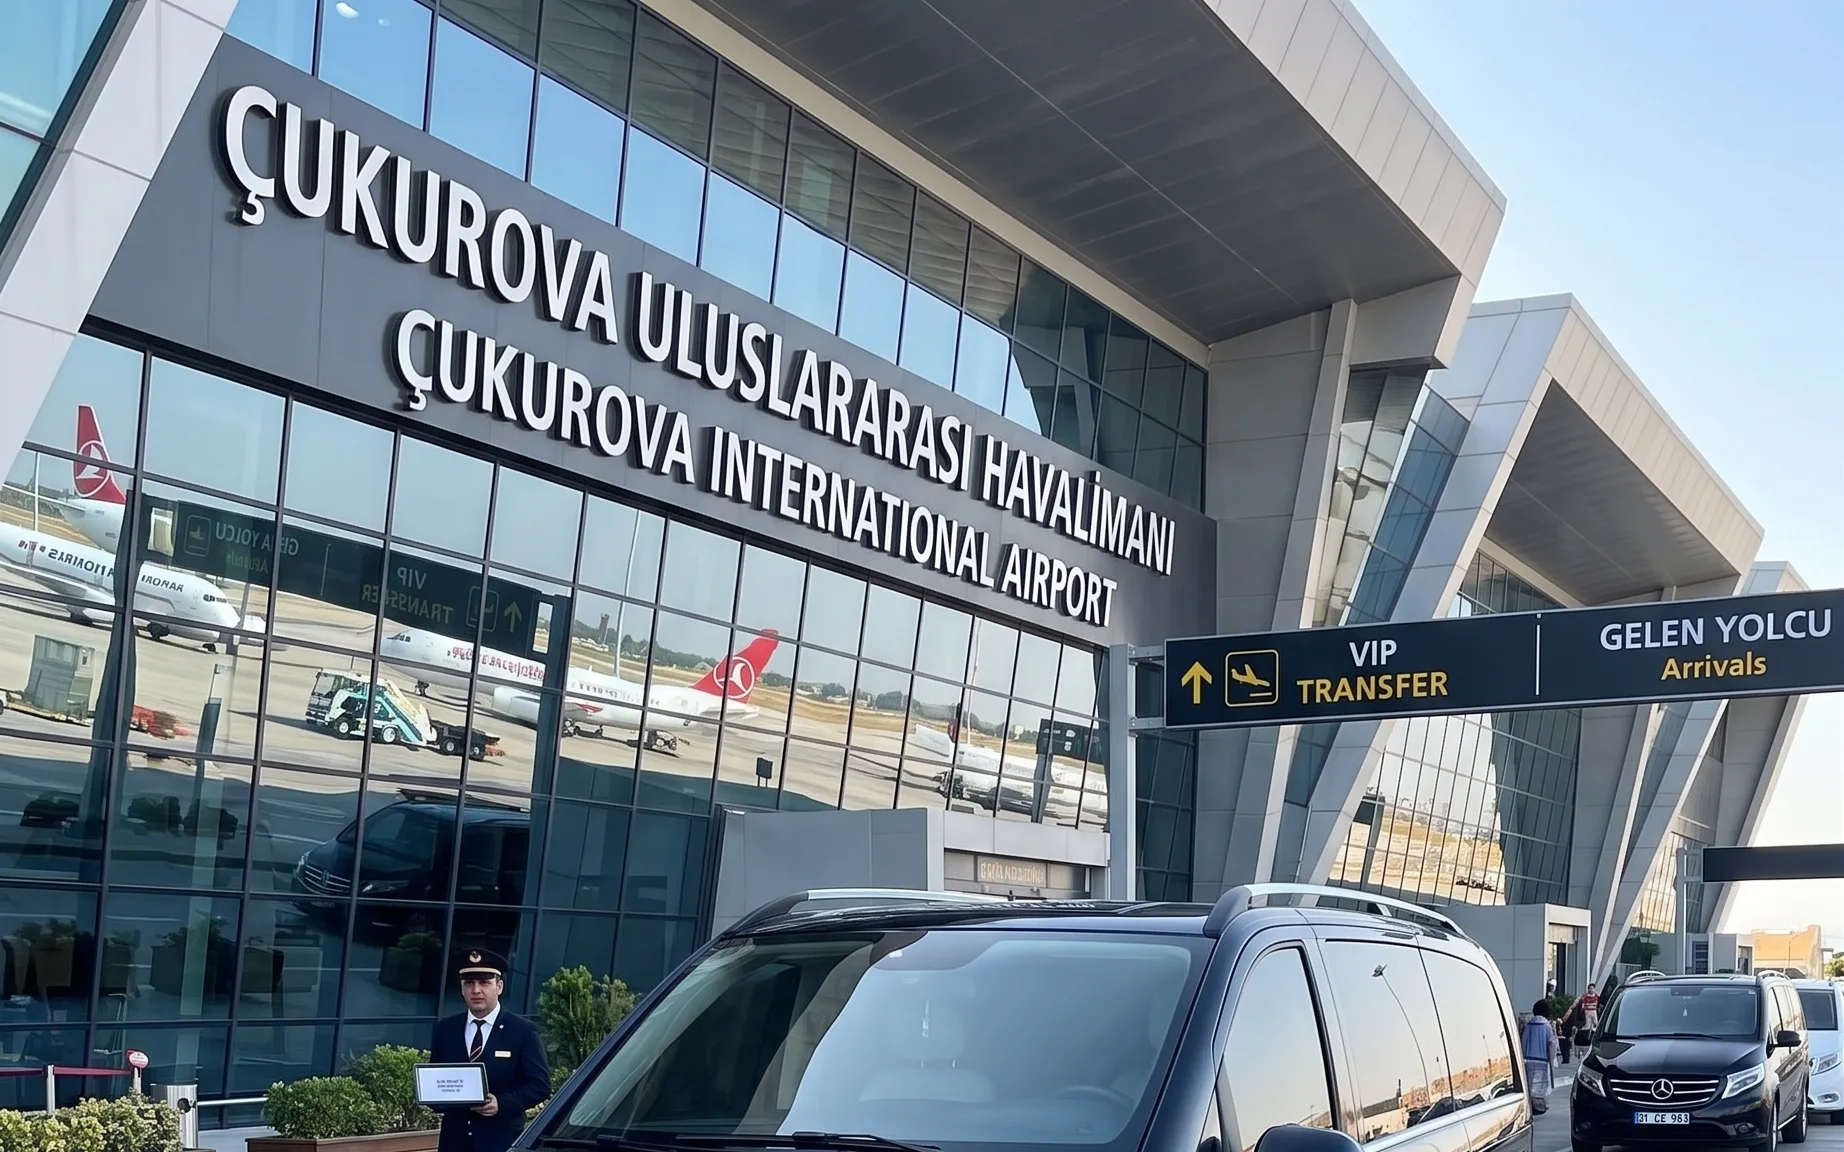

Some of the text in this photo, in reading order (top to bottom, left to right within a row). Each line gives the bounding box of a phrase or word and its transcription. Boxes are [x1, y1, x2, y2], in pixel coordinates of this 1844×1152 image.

[220, 85, 1176, 575] ÇUKUROVA ULUSLARARASI HAVALİMANI
[390, 309, 1118, 627] ÇUKUROVA INTERNATIONAL AIRPORT
[1600, 609, 1831, 651] GELEN YOLCU
[1349, 640, 1398, 667] VIP
[1661, 652, 1767, 680] Arrivals
[1297, 671, 1448, 704] TRANSFER
[1639, 1113, 1648, 1123] 31
[1654, 1113, 1667, 1123] CE
